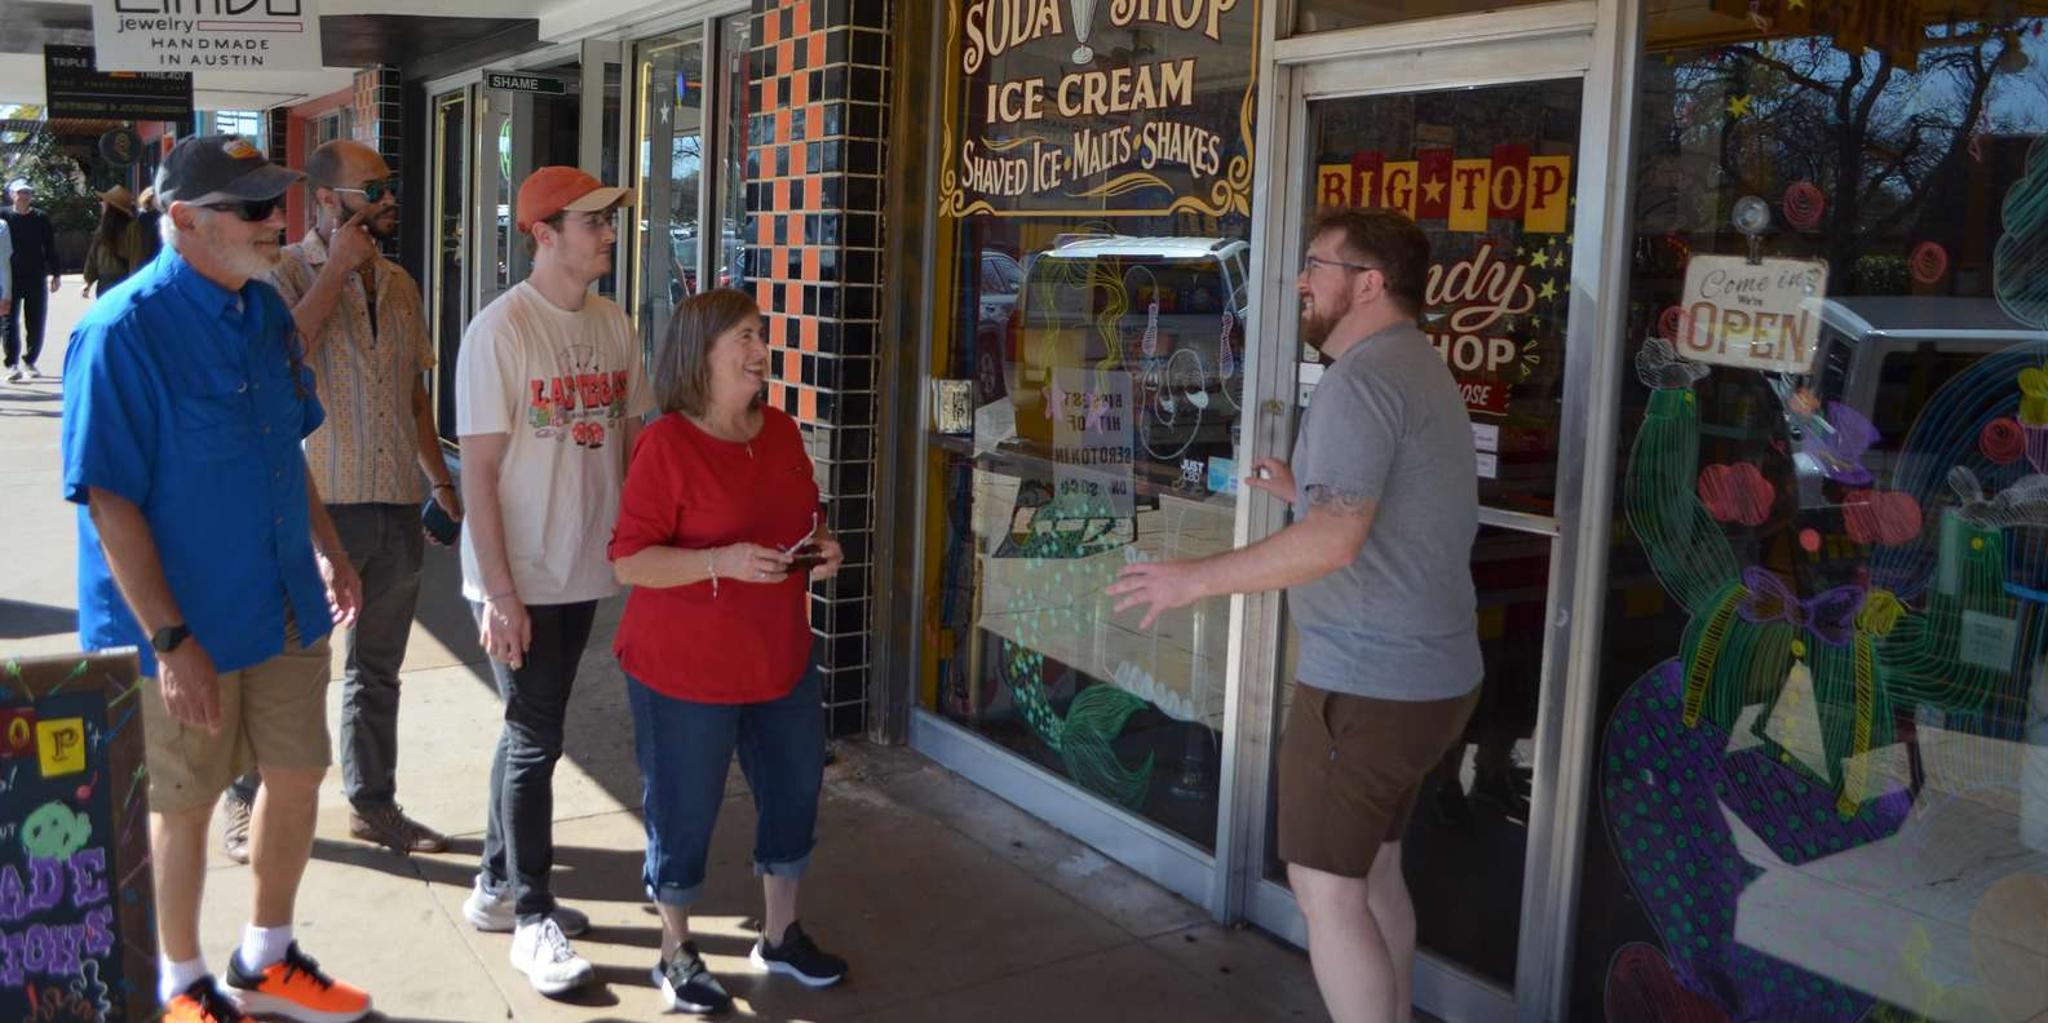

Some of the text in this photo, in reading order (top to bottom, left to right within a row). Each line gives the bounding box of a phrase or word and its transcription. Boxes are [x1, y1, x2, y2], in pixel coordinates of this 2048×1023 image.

[117, 15, 194, 34] jewelry
[963, 0, 1063, 75] SODA
[151, 38, 270, 51] HANDMADE
[52, 57, 88, 68] TRIPLE
[160, 54, 265, 66] IN AUSTIN
[493, 76, 539, 90] SHAME
[986, 59, 1196, 124] ICE CREAM
[962, 122, 1221, 197] SHAVED ICE MALTS SHAKES
[1322, 164, 1566, 219] BIG TOP
[1700, 269, 1769, 299] Come
[1686, 300, 1810, 363] OPEN
[1425, 333, 1516, 372] HOP
[1180, 458, 1204, 474] JUST
